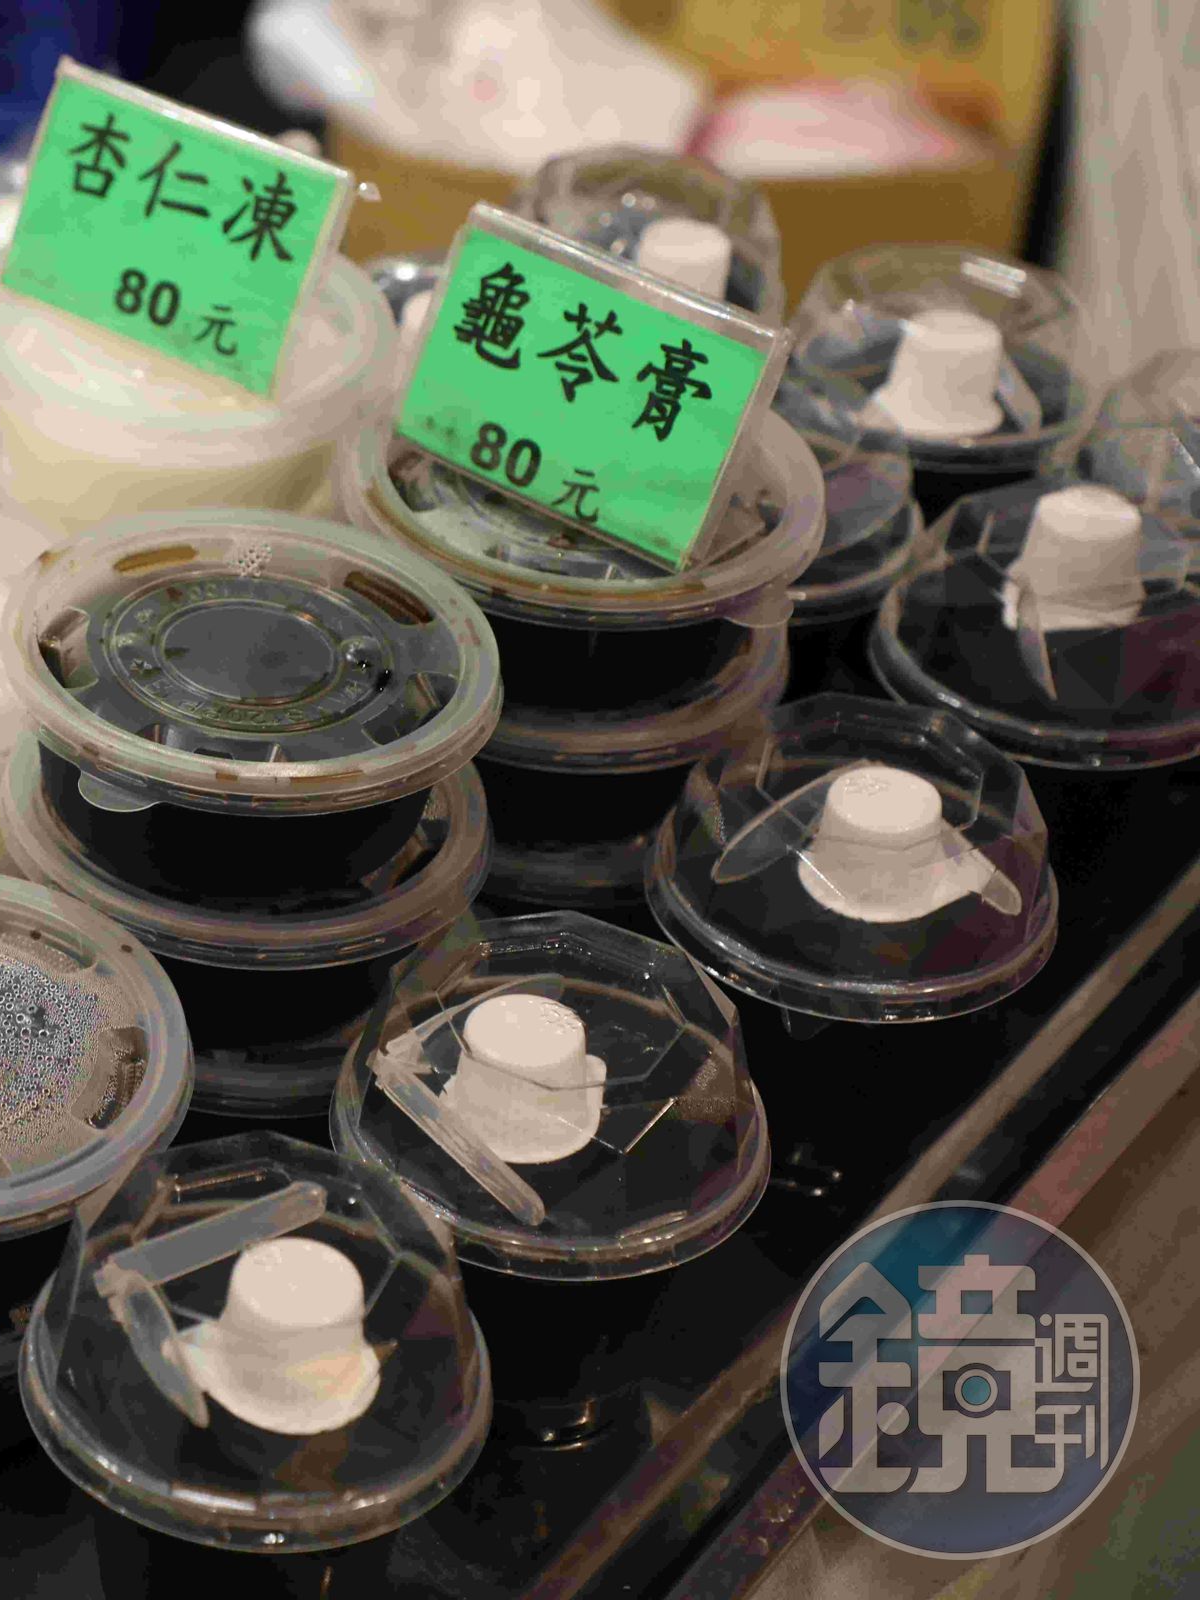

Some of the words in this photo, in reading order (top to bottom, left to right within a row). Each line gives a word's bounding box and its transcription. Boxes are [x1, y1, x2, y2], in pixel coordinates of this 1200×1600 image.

[67, 112, 298, 263] 杏仁凍
[114, 267, 181, 327] 80
[194, 303, 239, 357] 元
[453, 261, 713, 442] 龜苓膏
[469, 421, 543, 488] 80
[551, 467, 600, 524] 元
